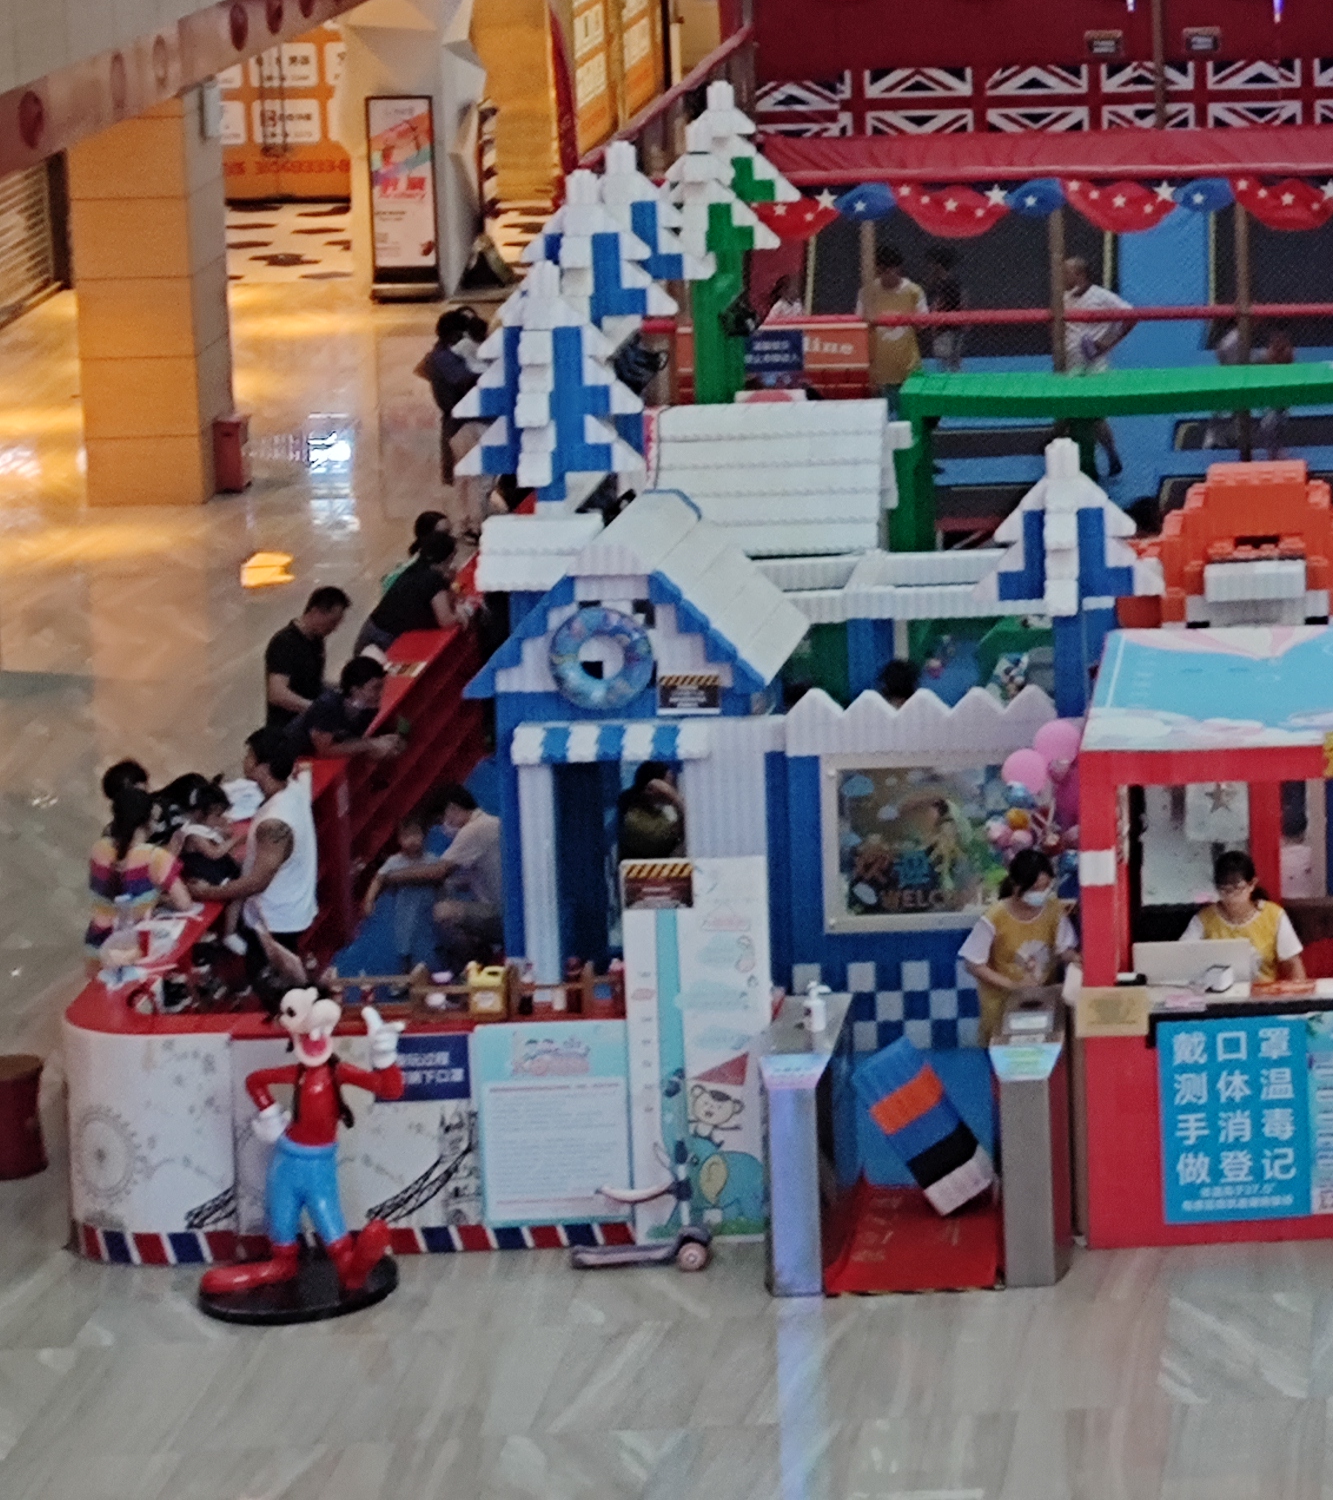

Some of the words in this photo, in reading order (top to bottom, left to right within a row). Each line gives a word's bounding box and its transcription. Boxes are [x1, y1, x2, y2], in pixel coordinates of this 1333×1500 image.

[1172, 1027, 1291, 1066] 戴口罩
[1174, 1067, 1294, 1105] 测体温
[1175, 1108, 1296, 1145] 手消毒
[1176, 1148, 1297, 1186] 做登记
